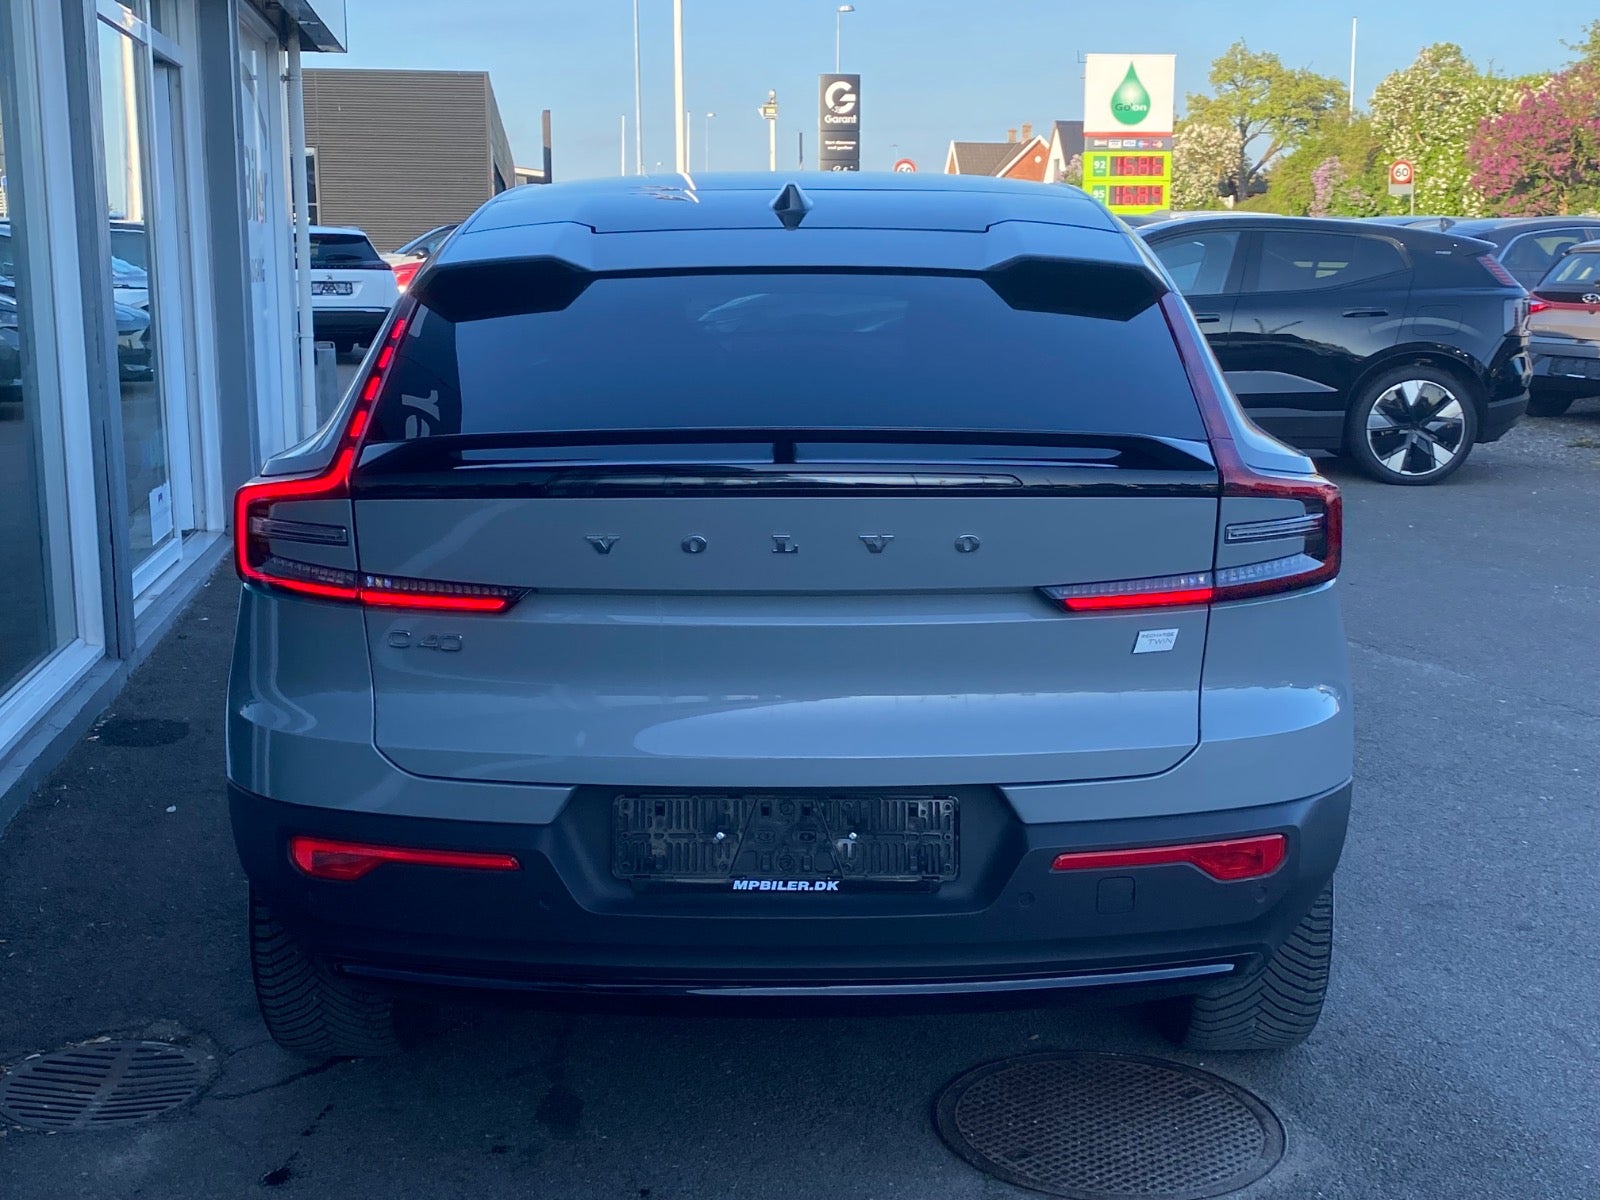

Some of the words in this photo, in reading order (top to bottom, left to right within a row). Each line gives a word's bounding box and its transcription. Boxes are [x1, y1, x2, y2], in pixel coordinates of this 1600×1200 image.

[824, 115, 857, 123] Garant
[1094, 160, 1106, 169] 92
[1395, 167, 1409, 177] 60
[584, 533, 982, 555] VOLVO
[732, 880, 840, 891] MPBILER.DK
